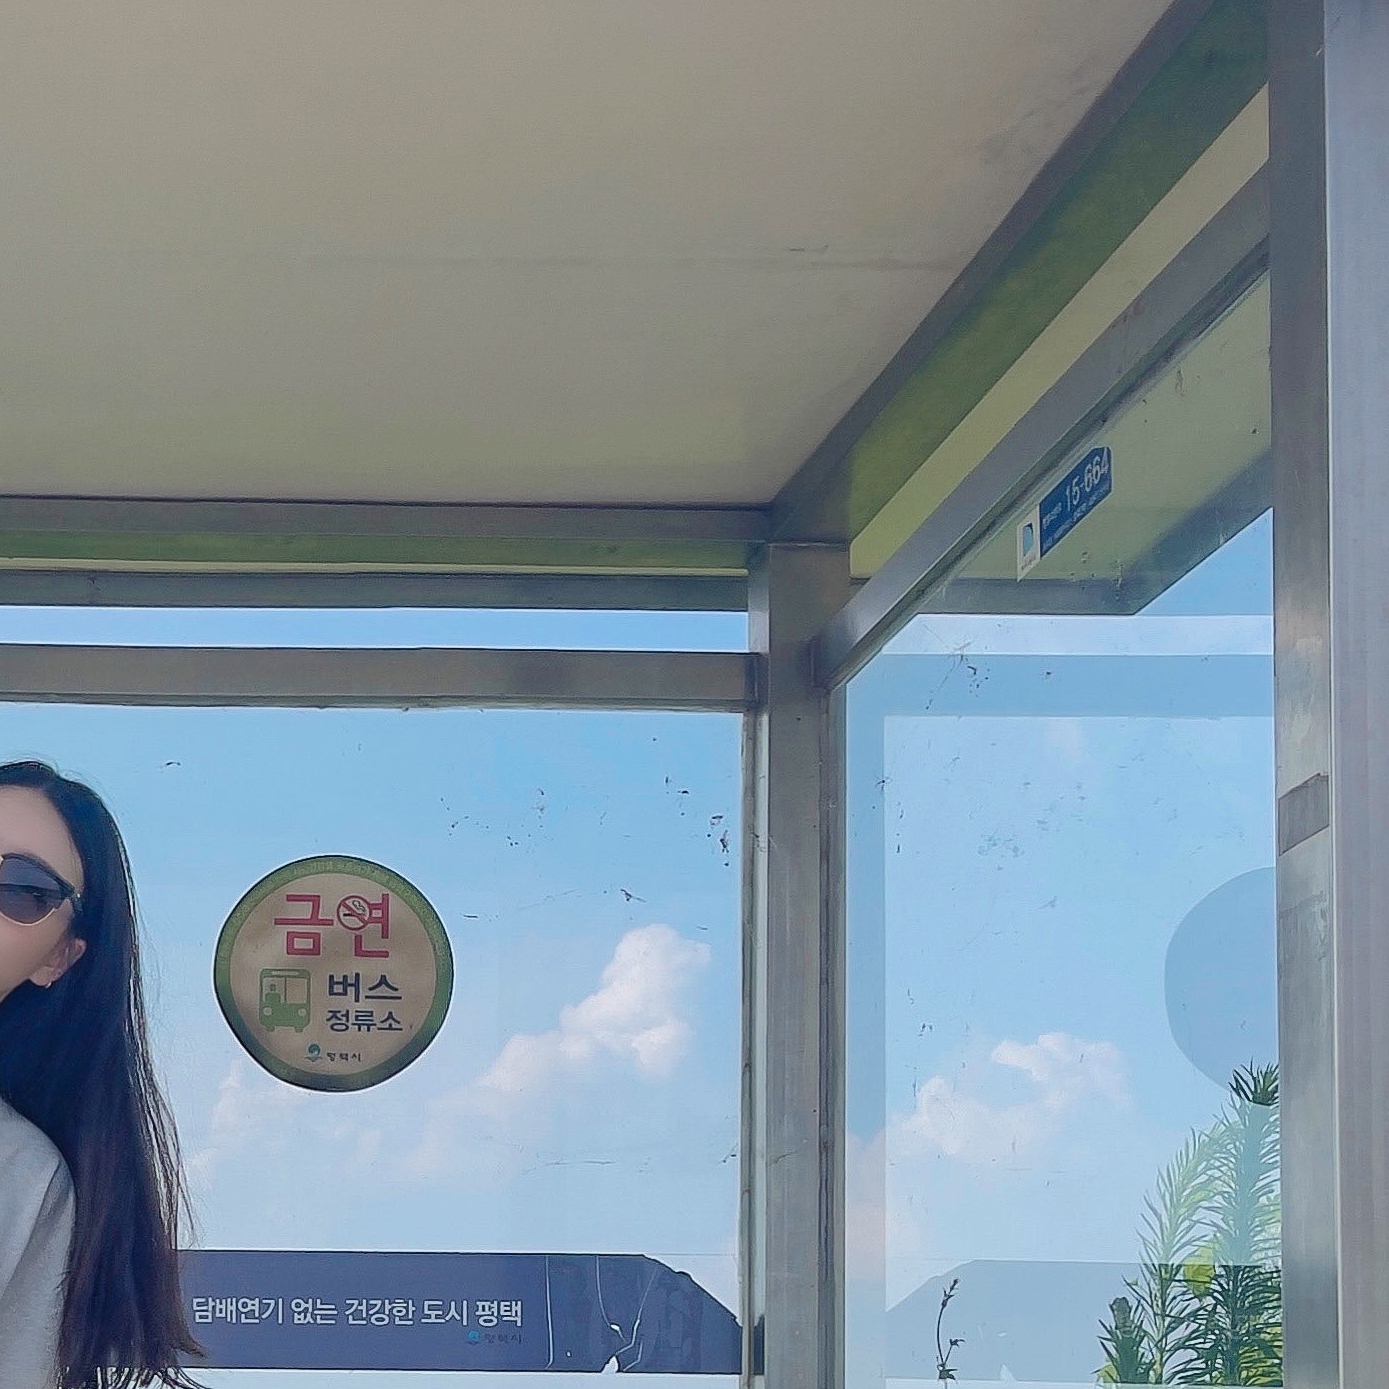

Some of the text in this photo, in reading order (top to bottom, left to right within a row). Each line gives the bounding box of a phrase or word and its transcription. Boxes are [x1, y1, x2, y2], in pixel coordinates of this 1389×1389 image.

[274, 893, 390, 958] 금연
[327, 972, 403, 1003] 버스
[326, 1009, 403, 1034] 정류소
[192, 1297, 523, 1327] 담배연기 없는 건강한 도시 평택
